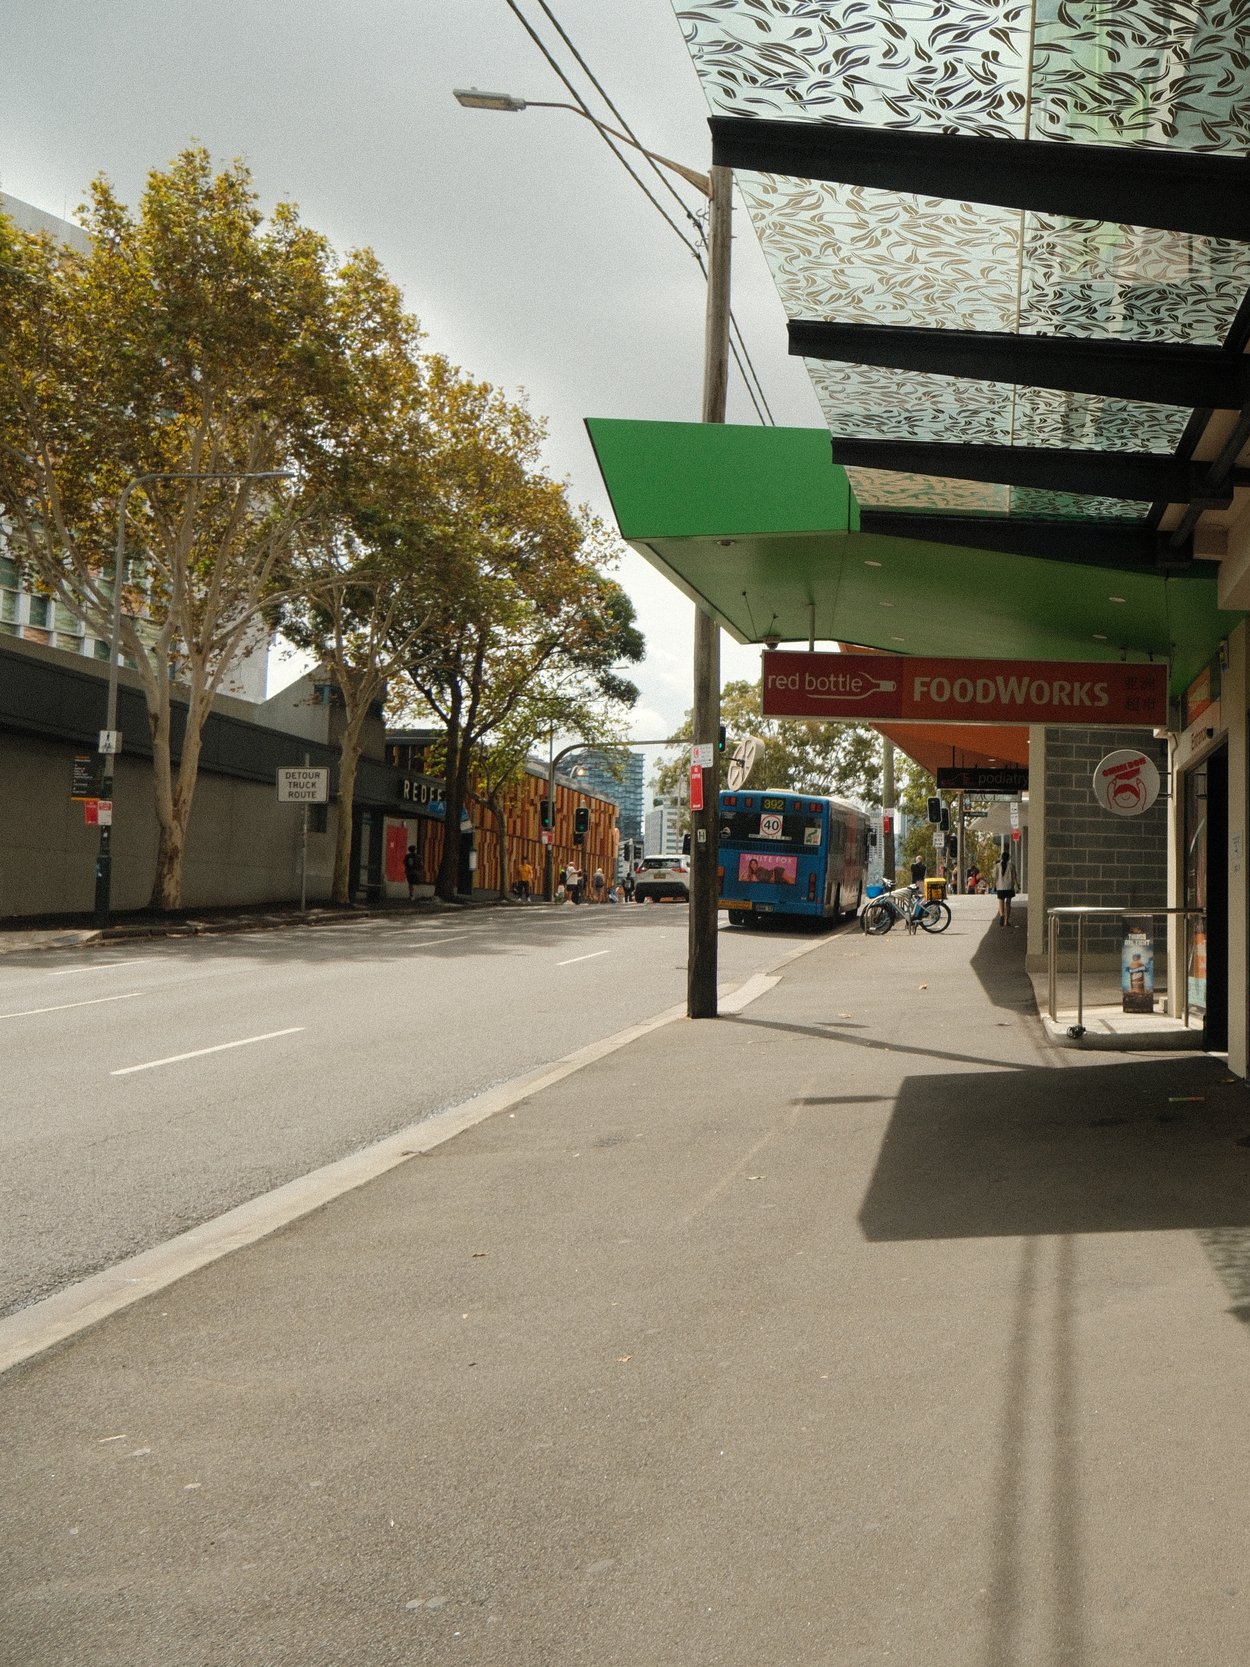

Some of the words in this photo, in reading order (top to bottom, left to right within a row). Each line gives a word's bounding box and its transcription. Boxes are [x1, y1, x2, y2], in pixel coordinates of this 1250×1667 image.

[768, 673, 799, 690] red
[805, 672, 863, 692] bottle
[913, 676, 1109, 707] FOODWORKS
[285, 772, 320, 780] DETOUR
[978, 773, 1027, 787] podiatry
[288, 781, 317, 789] TRUCK
[763, 799, 784, 810] 392
[763, 820, 779, 831] 40
